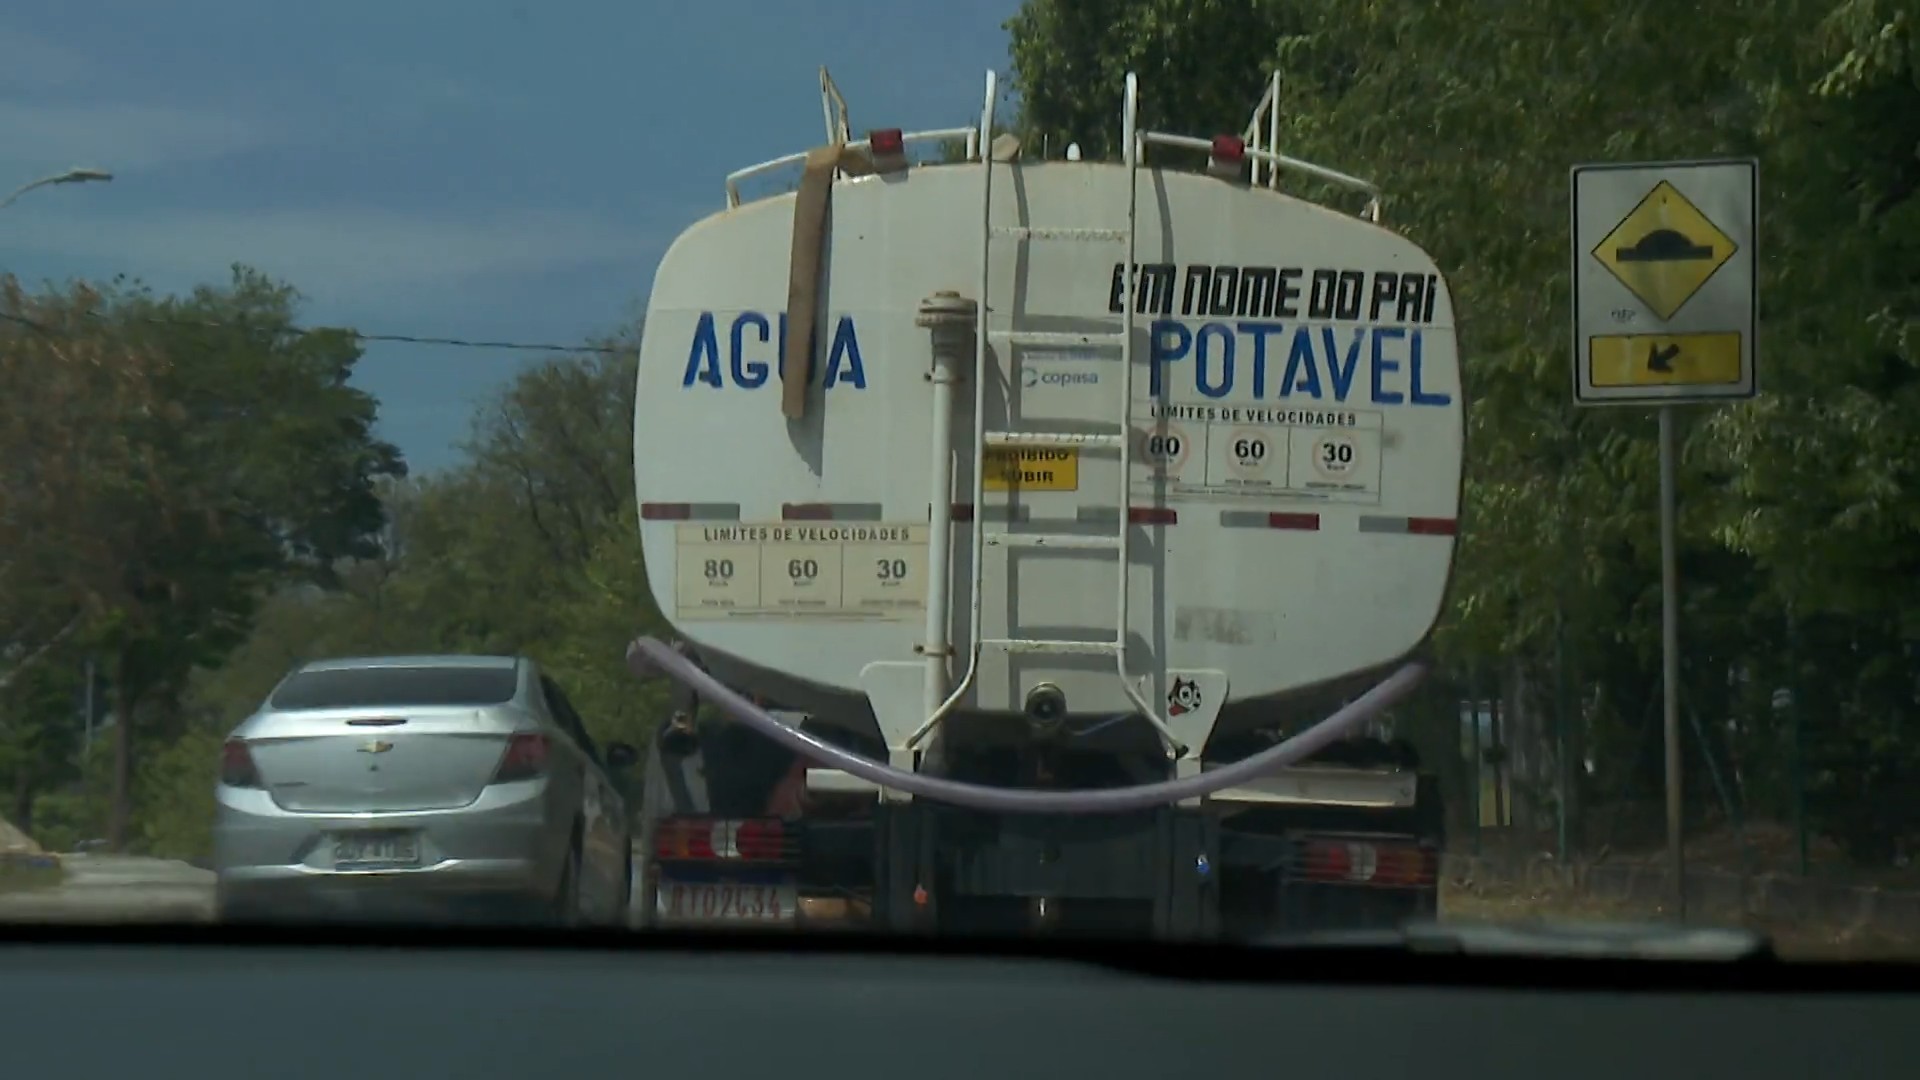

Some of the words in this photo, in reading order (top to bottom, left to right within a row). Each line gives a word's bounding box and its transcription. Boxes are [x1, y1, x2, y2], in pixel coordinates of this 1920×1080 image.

[1109, 263, 1176, 314] EM
[1182, 265, 1303, 318] NOME
[1308, 269, 1364, 321] DO
[1369, 271, 1438, 322] PAI
[1150, 320, 1451, 405] POTAVEL
[1041, 372, 1098, 387] copasa
[1151, 405, 1216, 420] LIMITES
[1222, 408, 1241, 421] DE
[1247, 409, 1356, 426] VELOCIDADES
[1150, 435, 1180, 456] 80
[1235, 439, 1265, 459] 60
[1323, 443, 1352, 463] 30
[704, 528, 767, 541] LIMITES
[773, 528, 792, 540] DE
[799, 527, 909, 541] VELOCIDADES
[704, 559, 734, 579] 80
[788, 559, 818, 579] 60
[876, 559, 907, 579] 30
